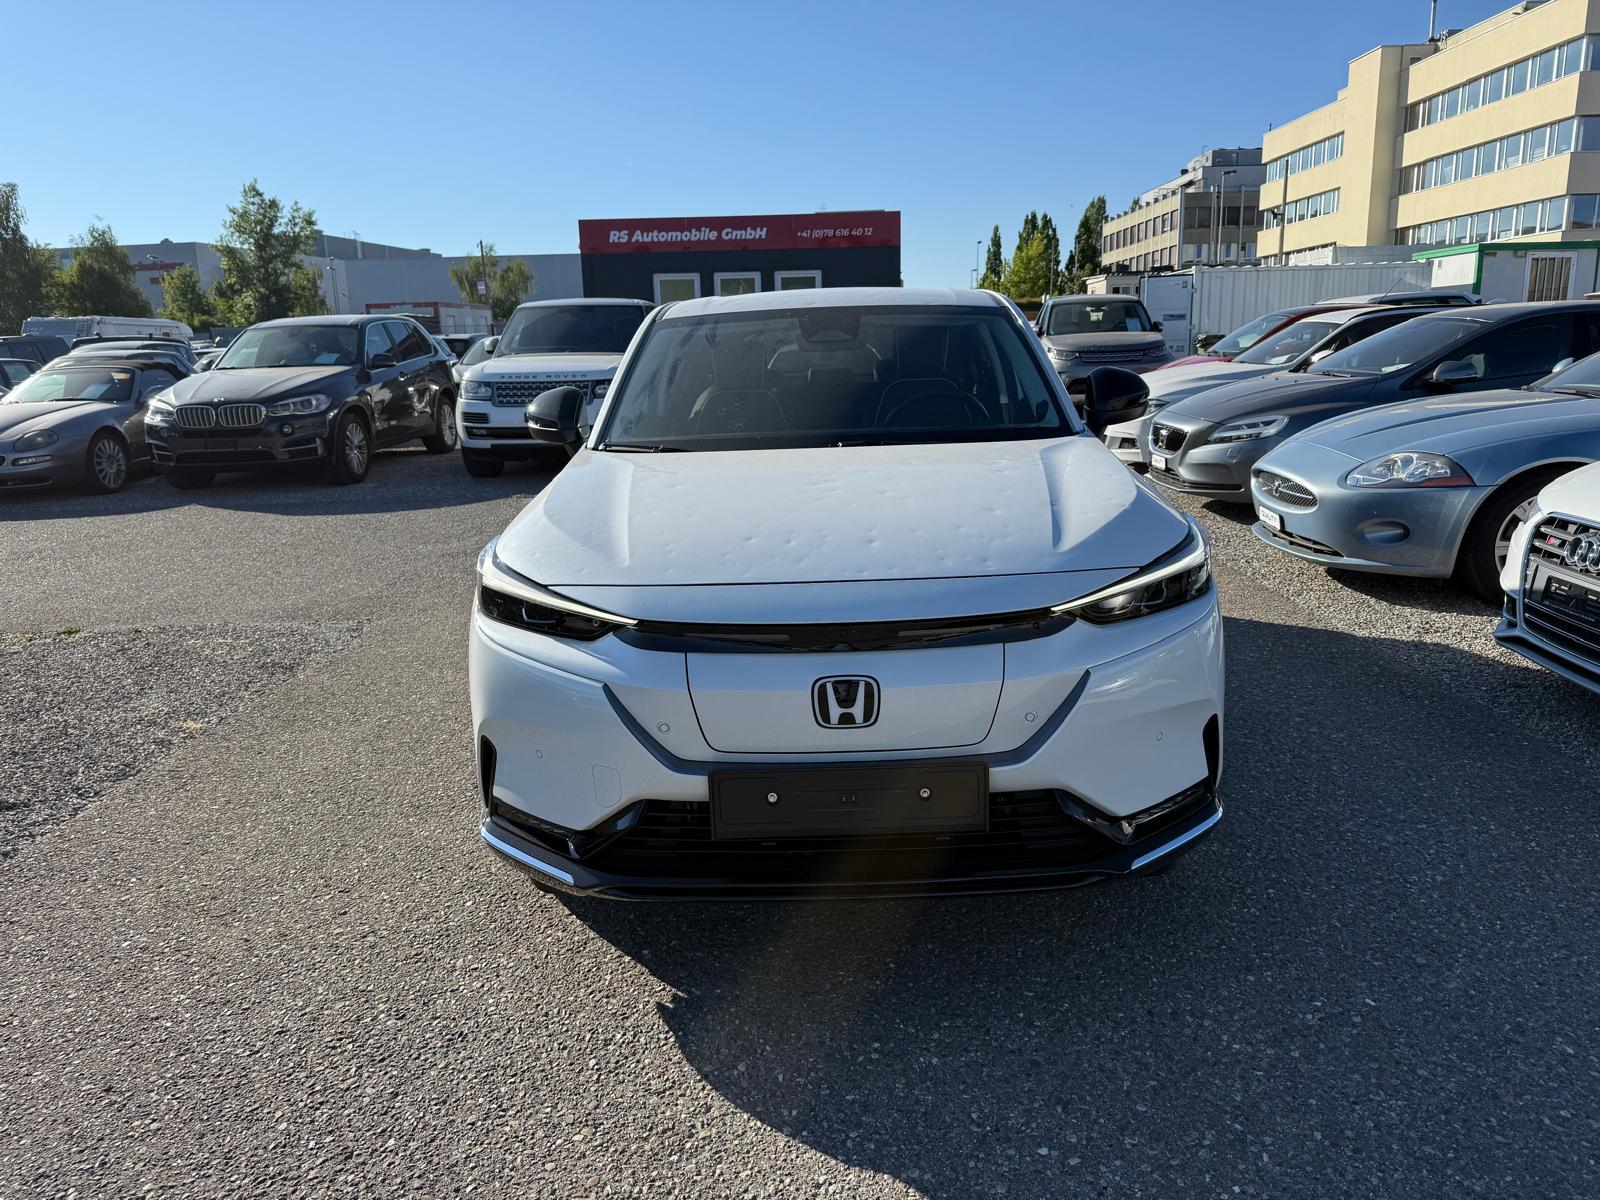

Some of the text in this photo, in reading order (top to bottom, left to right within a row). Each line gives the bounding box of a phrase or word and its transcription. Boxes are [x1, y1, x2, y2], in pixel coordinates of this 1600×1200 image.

[608, 227, 767, 243] RS Automobile GmbH
[797, 227, 873, 239] +41 (0)78 616 40 12
